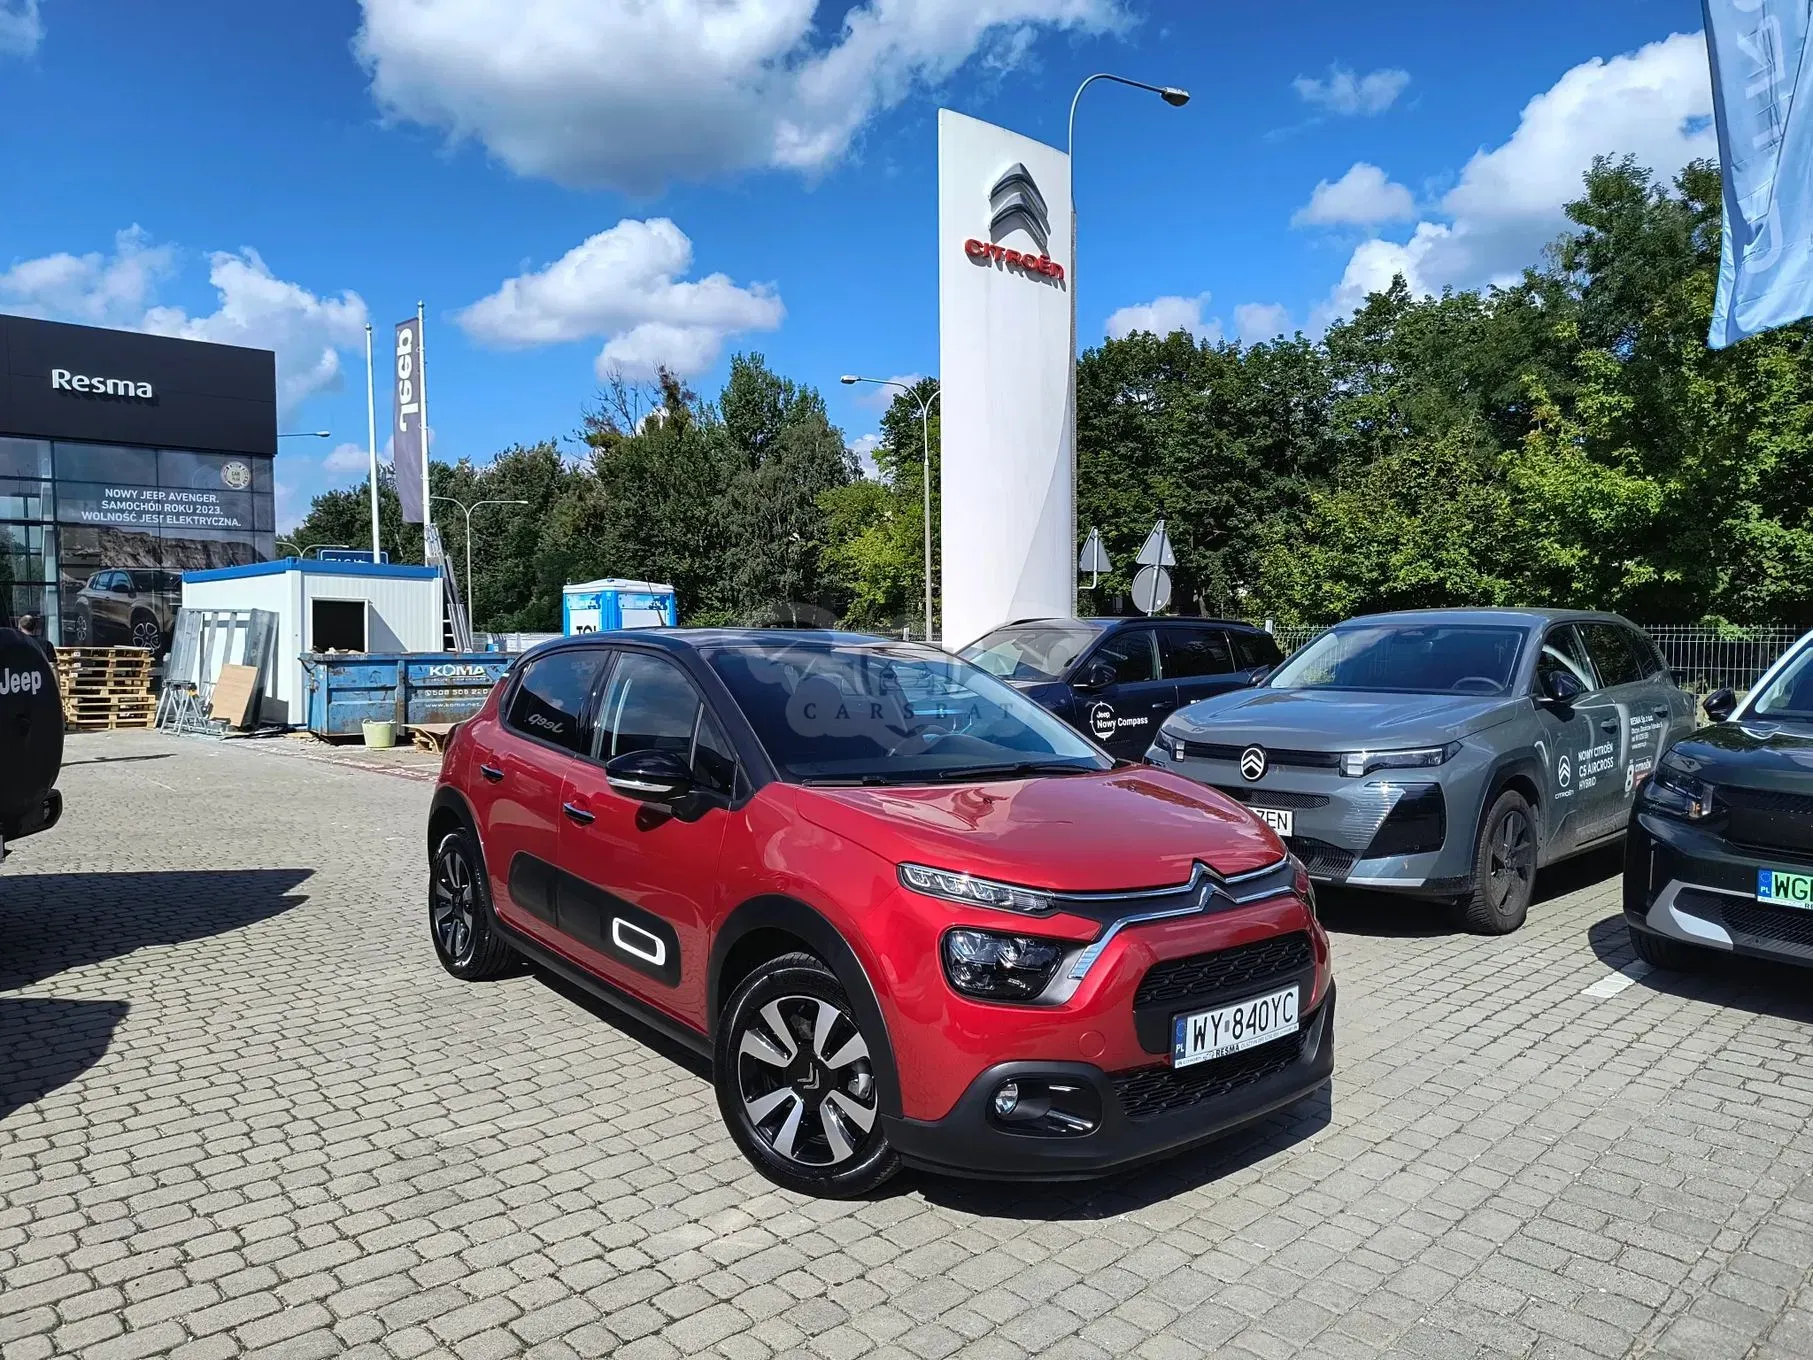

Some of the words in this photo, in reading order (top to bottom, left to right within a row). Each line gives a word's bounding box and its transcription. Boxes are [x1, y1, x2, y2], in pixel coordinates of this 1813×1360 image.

[965, 239, 1064, 280] CITROËN
[52, 369, 152, 398] Resma
[105, 489, 138, 498] NOWY
[169, 493, 219, 503] AVENGER.
[164, 504, 193, 513] ROKU
[196, 505, 223, 514] 2023.
[81, 510, 137, 522] WOLNOŚĆ
[139, 514, 164, 523] JEST
[166, 515, 242, 527] ELEKTRYCZNA.
[430, 664, 485, 676] KOMA
[0, 668, 41, 695] Jeep
[1096, 711, 1110, 719] Jeep
[1097, 720, 1116, 730] Nowy
[1118, 717, 1148, 727] Compass
[1578, 749, 1593, 762] NOWY
[1579, 765, 1587, 777] C5
[1588, 757, 1613, 775] AIRCROSS
[1761, 886, 1770, 894] PL
[1775, 874, 1813, 902] WG
[1194, 1012, 1223, 1052] WY
[1232, 992, 1293, 1040] 840YC
[1176, 1044, 1184, 1053] PL
[1215, 1044, 1240, 1058] RESMA
